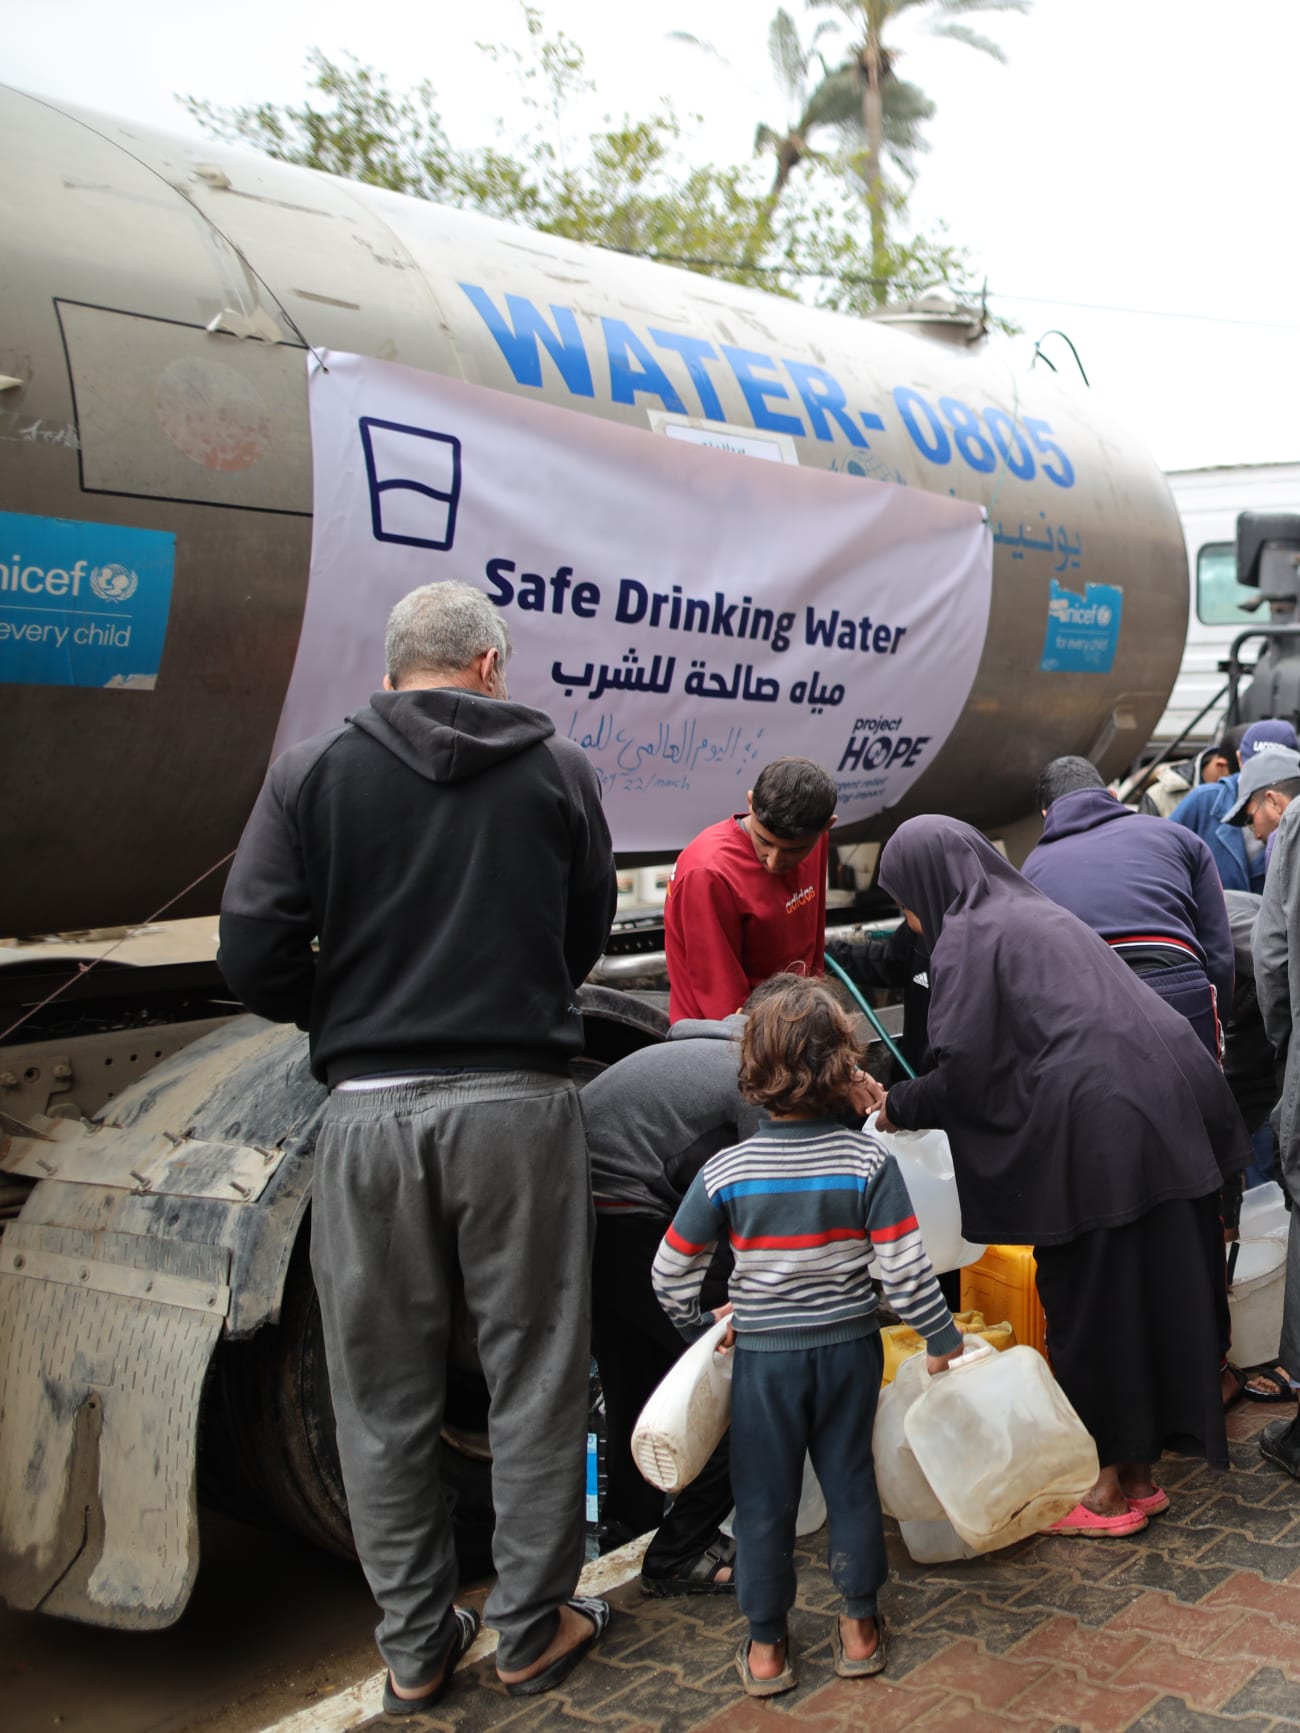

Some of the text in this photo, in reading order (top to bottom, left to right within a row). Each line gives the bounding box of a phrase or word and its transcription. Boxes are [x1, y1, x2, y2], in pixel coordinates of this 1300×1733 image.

[485, 558, 907, 655] Safe Drinking Water
[73, 622, 132, 648] child
[551, 648, 846, 714] مياه صالحة للشرب
[852, 715, 902, 735] project
[837, 736, 932, 772] HOPE
